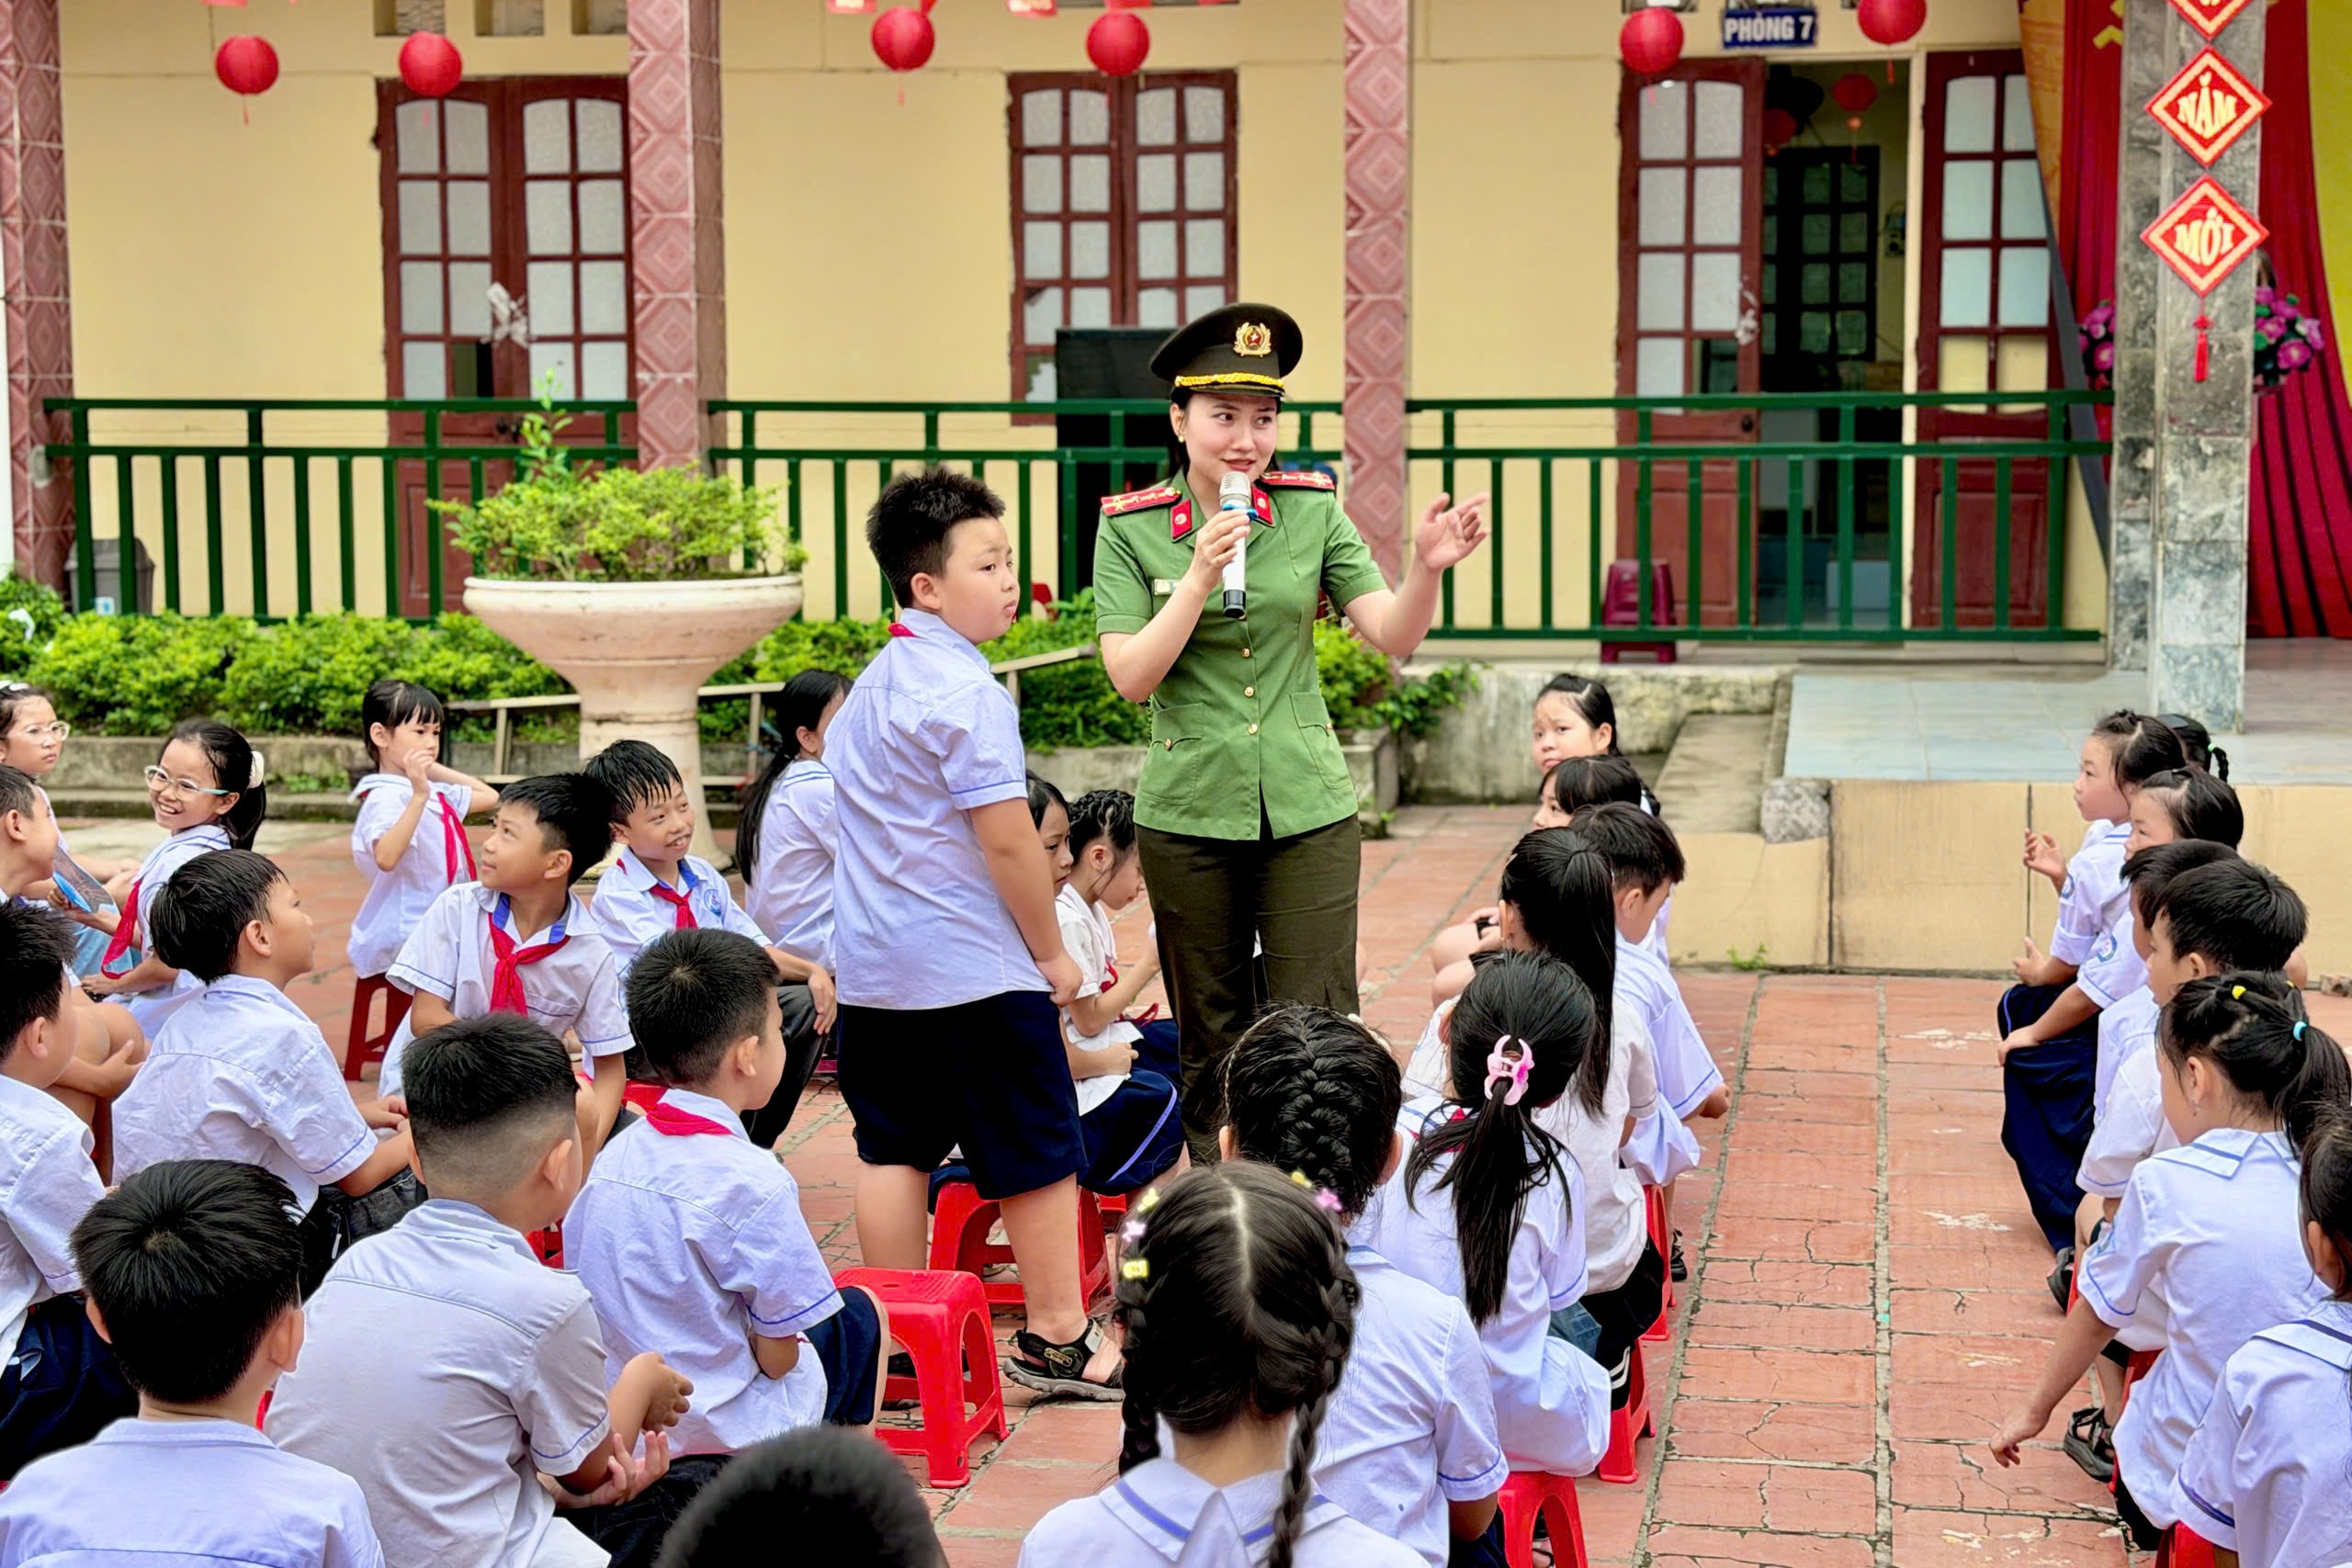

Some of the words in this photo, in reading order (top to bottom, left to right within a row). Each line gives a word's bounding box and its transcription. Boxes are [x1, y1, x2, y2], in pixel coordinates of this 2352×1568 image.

[1724, 11, 1794, 42] PHÒNG
[1799, 15, 1814, 40] 7
[2177, 71, 2236, 139] NĂM
[2174, 206, 2235, 266] MỚI
